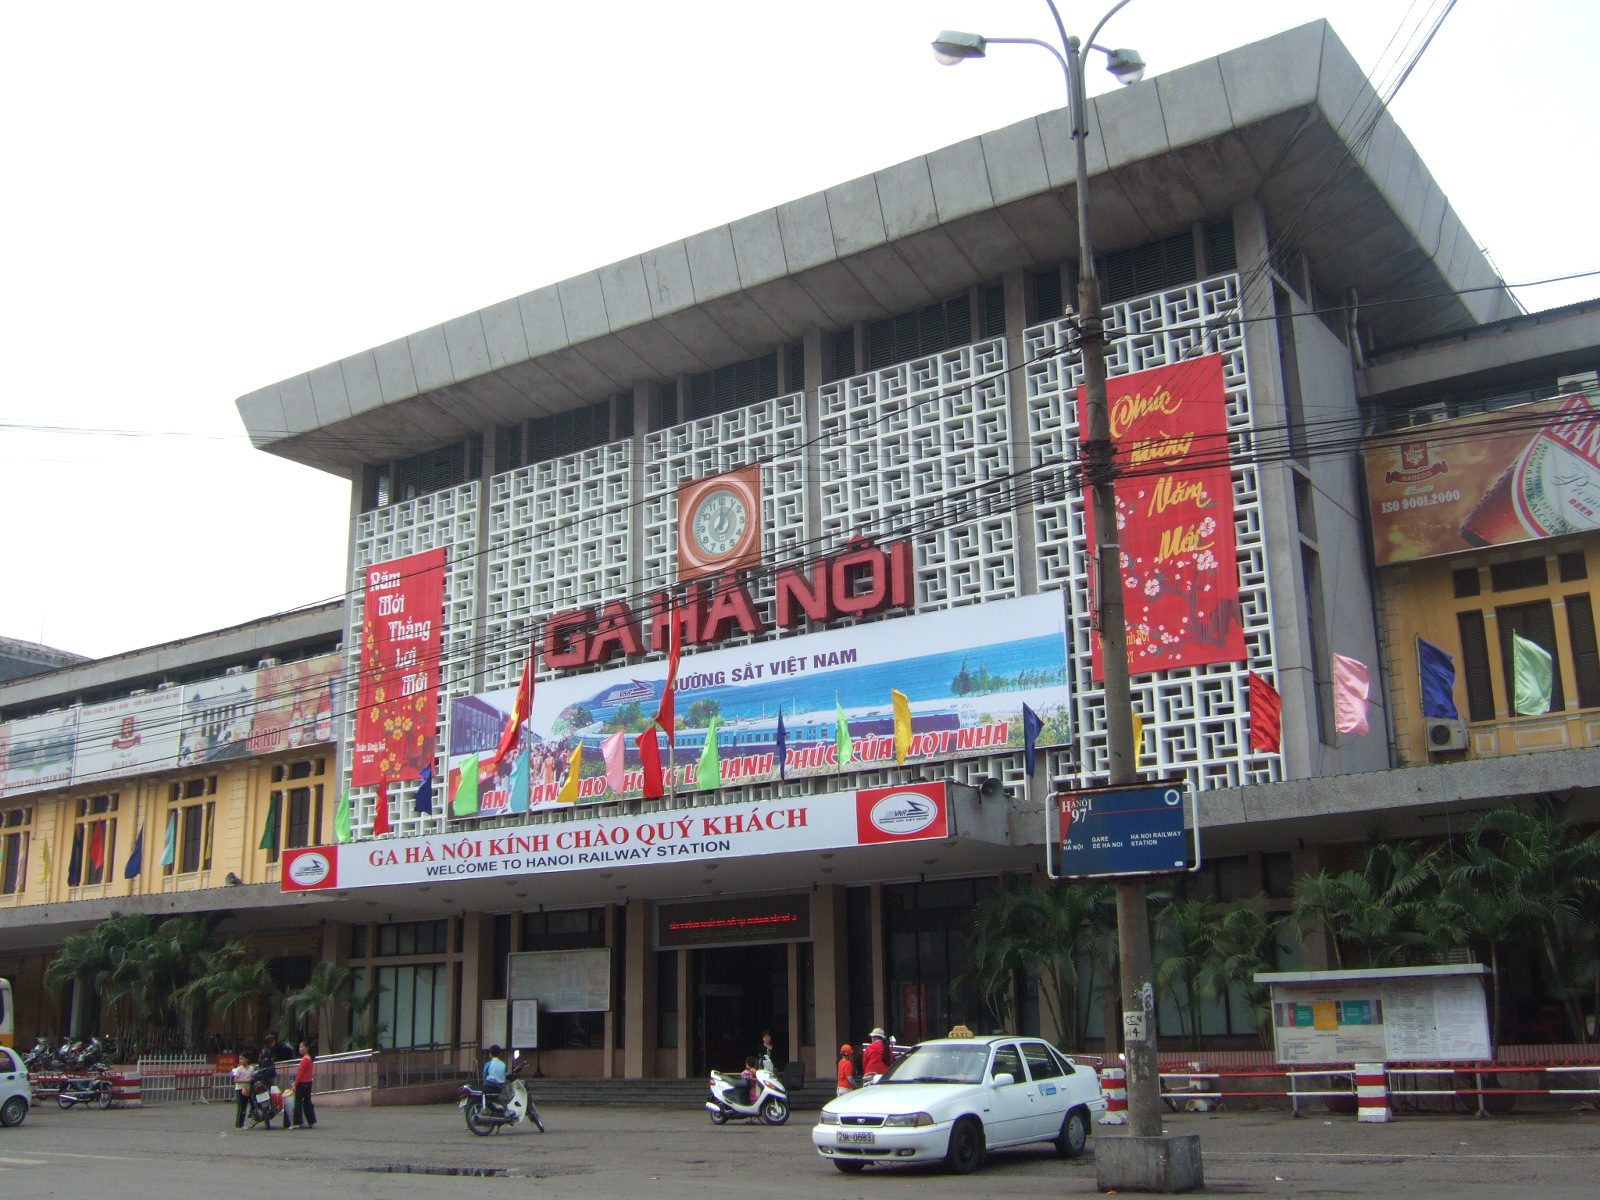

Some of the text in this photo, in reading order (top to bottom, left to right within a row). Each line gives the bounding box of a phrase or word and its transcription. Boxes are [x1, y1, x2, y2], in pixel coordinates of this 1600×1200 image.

[1110, 385, 1182, 438] Chúc
[1148, 475, 1212, 518] Năm
[1381, 501, 1399, 513] ISO
[736, 505, 742, 513] 2
[739, 516, 744, 524] 3
[703, 536, 709, 544] 8
[711, 543, 716, 551] 7
[730, 539, 735, 547] 5
[379, 593, 405, 616] Mới
[543, 533, 915, 669] GA HÀ NỘI
[388, 615, 432, 641] Thắng
[732, 662, 764, 682] SẮT
[770, 655, 808, 676] VIỆT
[814, 649, 857, 669] NAM
[482, 788, 506, 809] AN
[957, 720, 1009, 751] NHÀ
[1072, 808, 1087, 824] 97
[368, 807, 808, 867] GA HÀ NỘI KÍNH CHÀO QUÝ KHÁCH
[427, 840, 730, 877] WELCOME TO HANOI RAILWAY STATION
